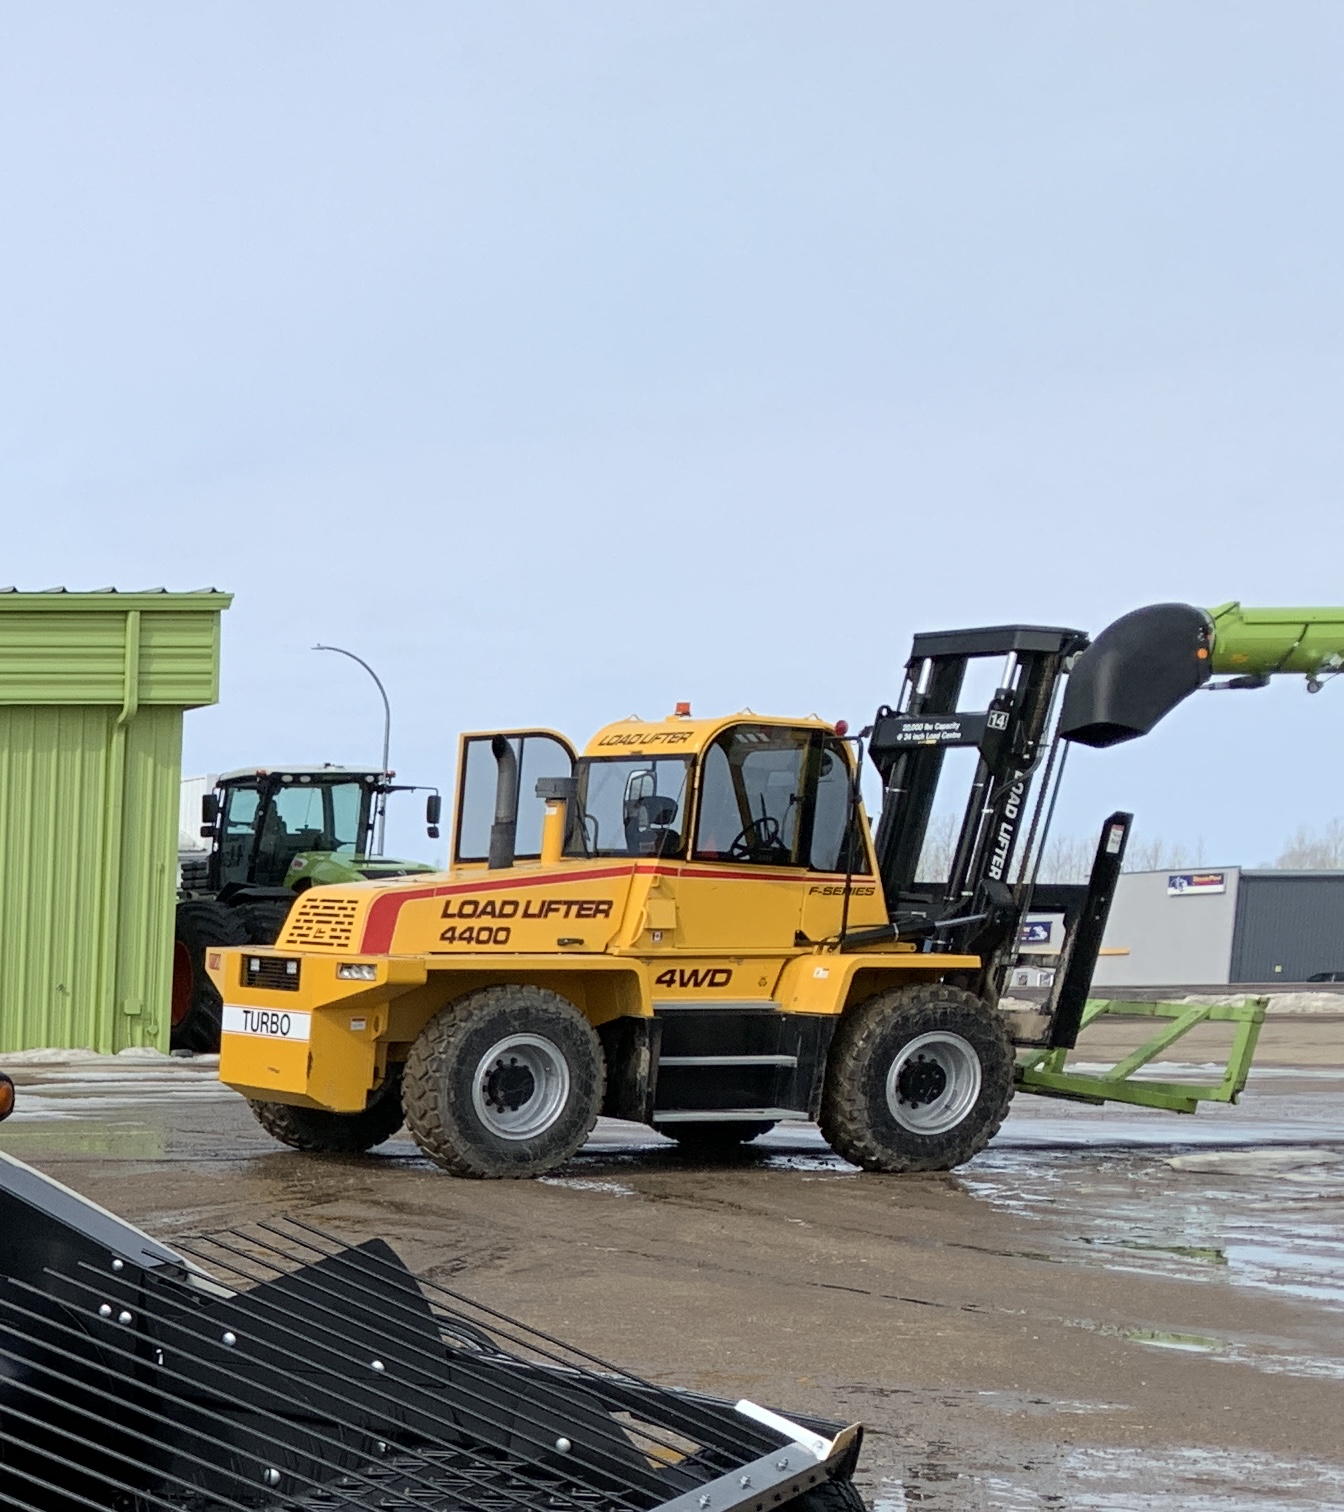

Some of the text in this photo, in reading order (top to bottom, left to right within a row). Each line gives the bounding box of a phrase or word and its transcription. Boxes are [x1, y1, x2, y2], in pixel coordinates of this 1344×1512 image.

[991, 713, 1006, 727] 14
[598, 731, 695, 746] LOAD LIFTER
[988, 822, 1013, 880] LIFTER
[441, 900, 613, 918] LOAD LIFTER
[440, 926, 511, 944] 4400
[655, 968, 733, 988] 4WD
[243, 1010, 291, 1035] TURBO
